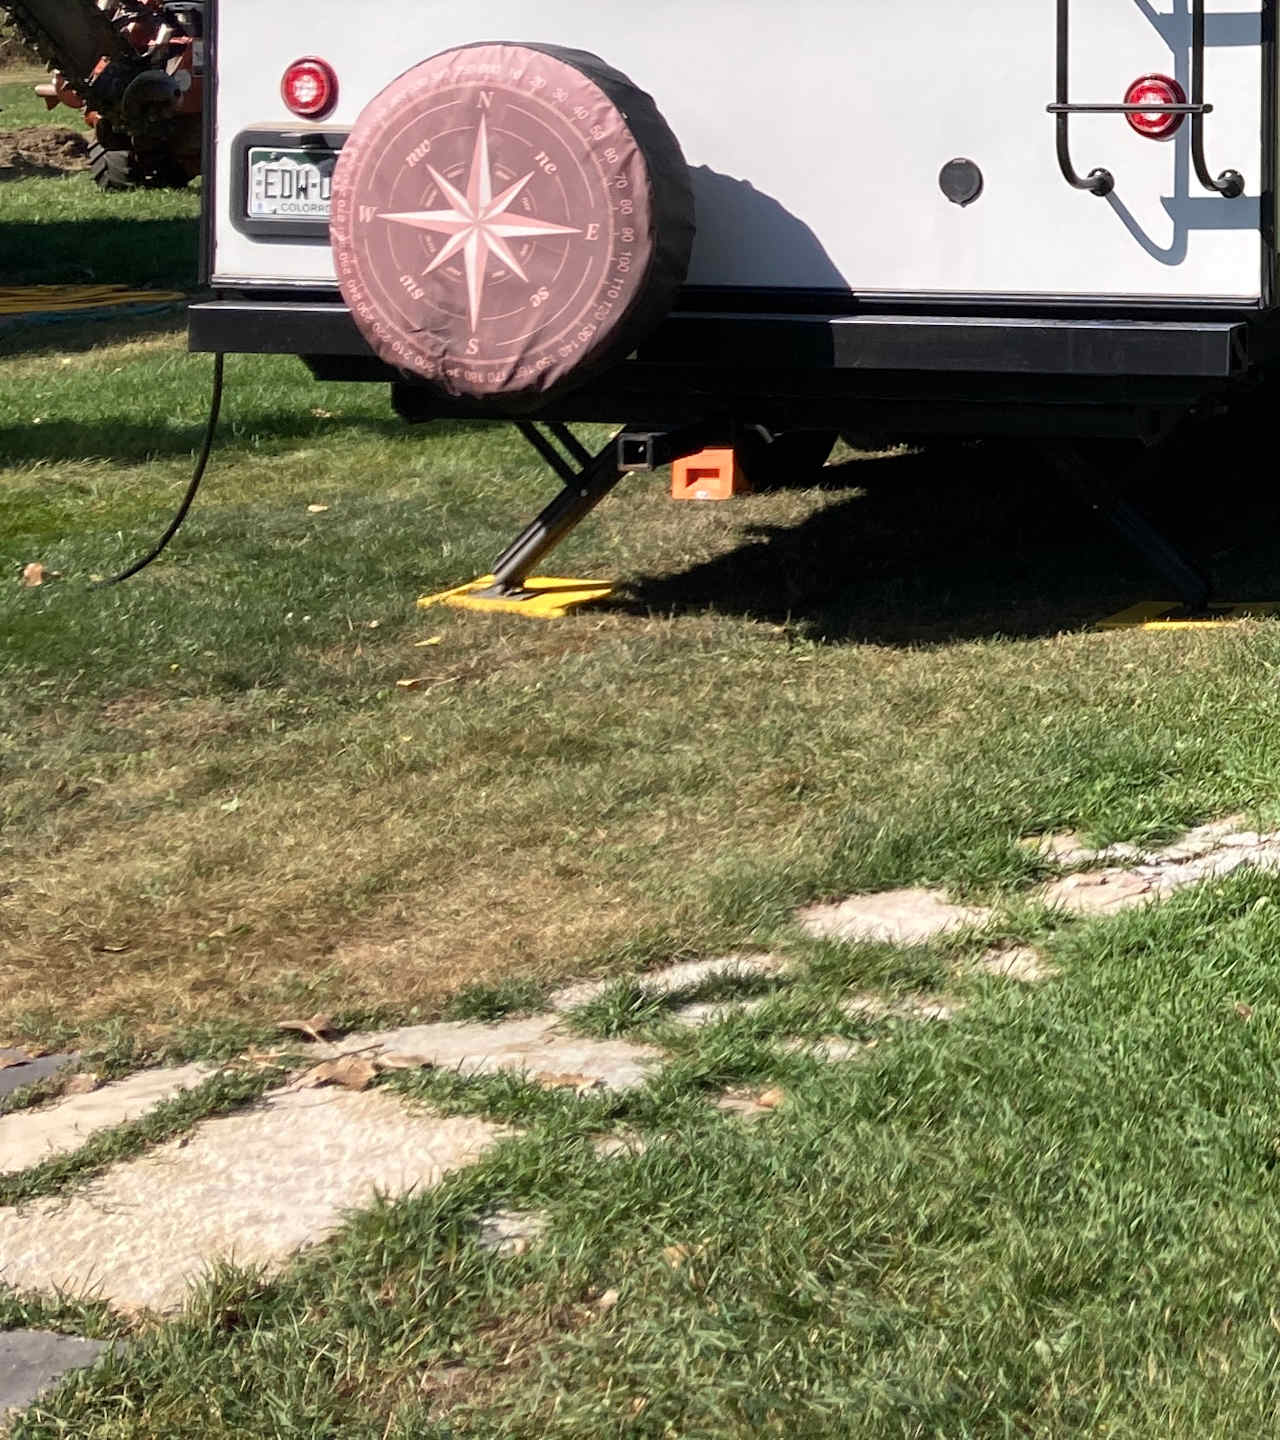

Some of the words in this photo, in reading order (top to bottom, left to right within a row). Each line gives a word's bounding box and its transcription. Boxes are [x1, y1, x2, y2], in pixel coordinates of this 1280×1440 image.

[476, 90, 494, 109] N
[359, 205, 377, 223] W
[584, 223, 600, 241] E
[465, 338, 480, 355] S
